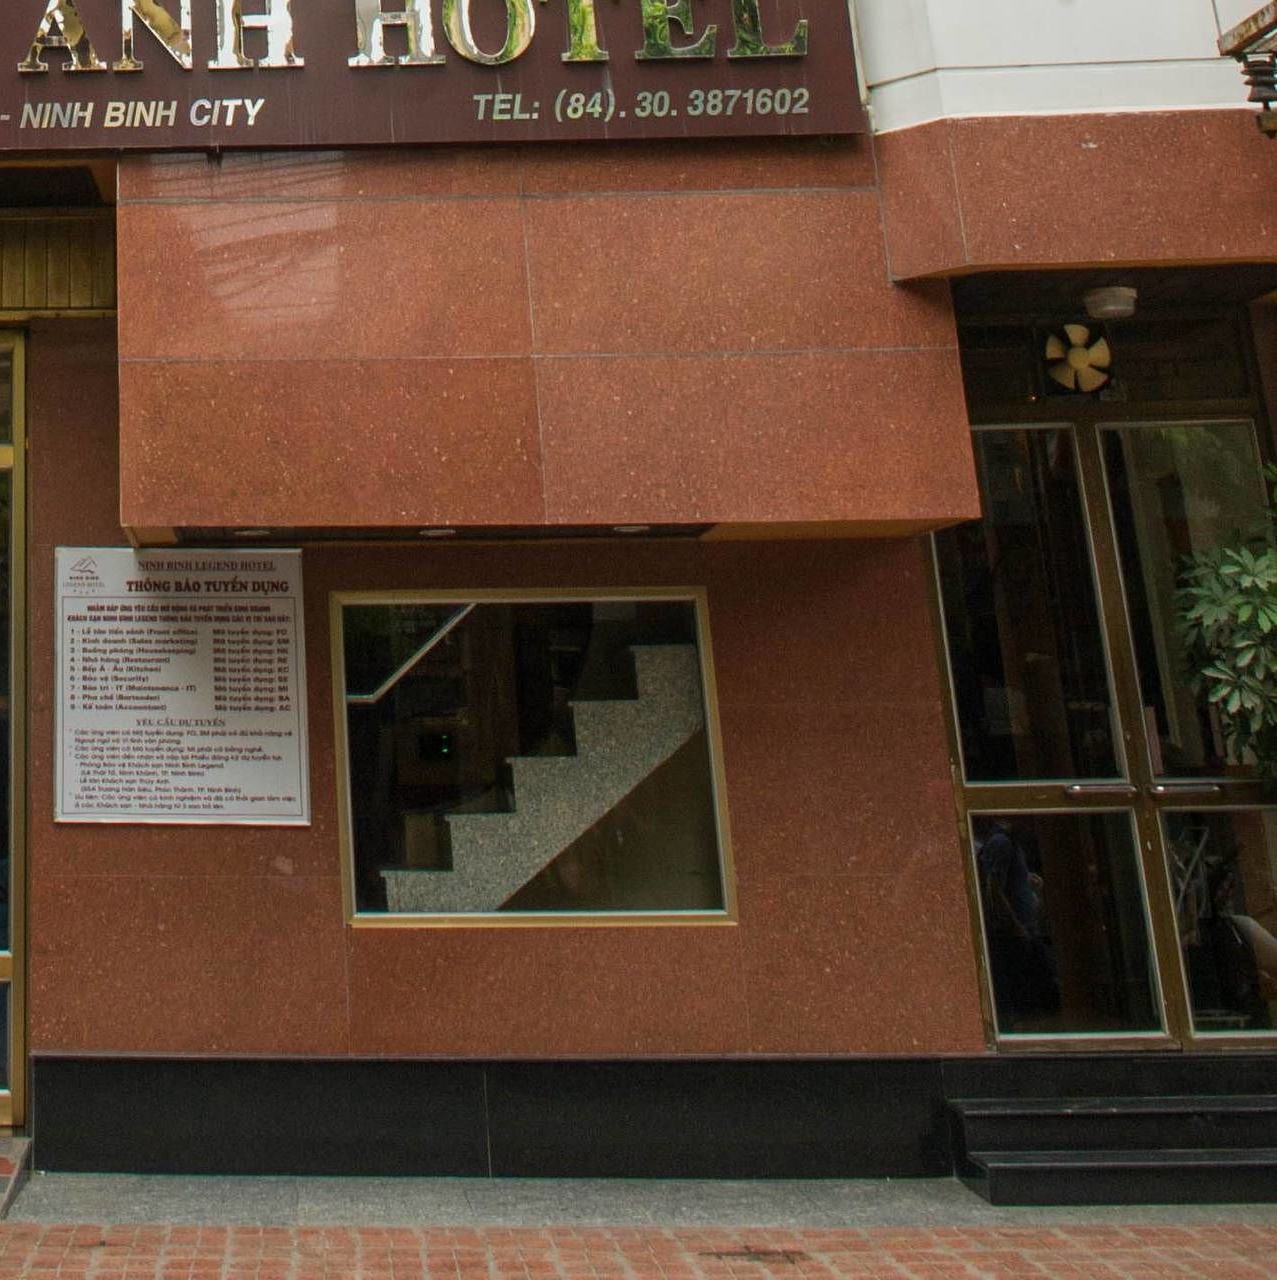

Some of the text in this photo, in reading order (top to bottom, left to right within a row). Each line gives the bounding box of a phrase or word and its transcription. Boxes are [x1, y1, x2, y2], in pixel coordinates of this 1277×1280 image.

[19, 102, 94, 129] NINH
[103, 100, 178, 128] BINH
[189, 98, 265, 127] CITY
[472, 93, 540, 121] TEL:
[686, 88, 810, 117] 3871602
